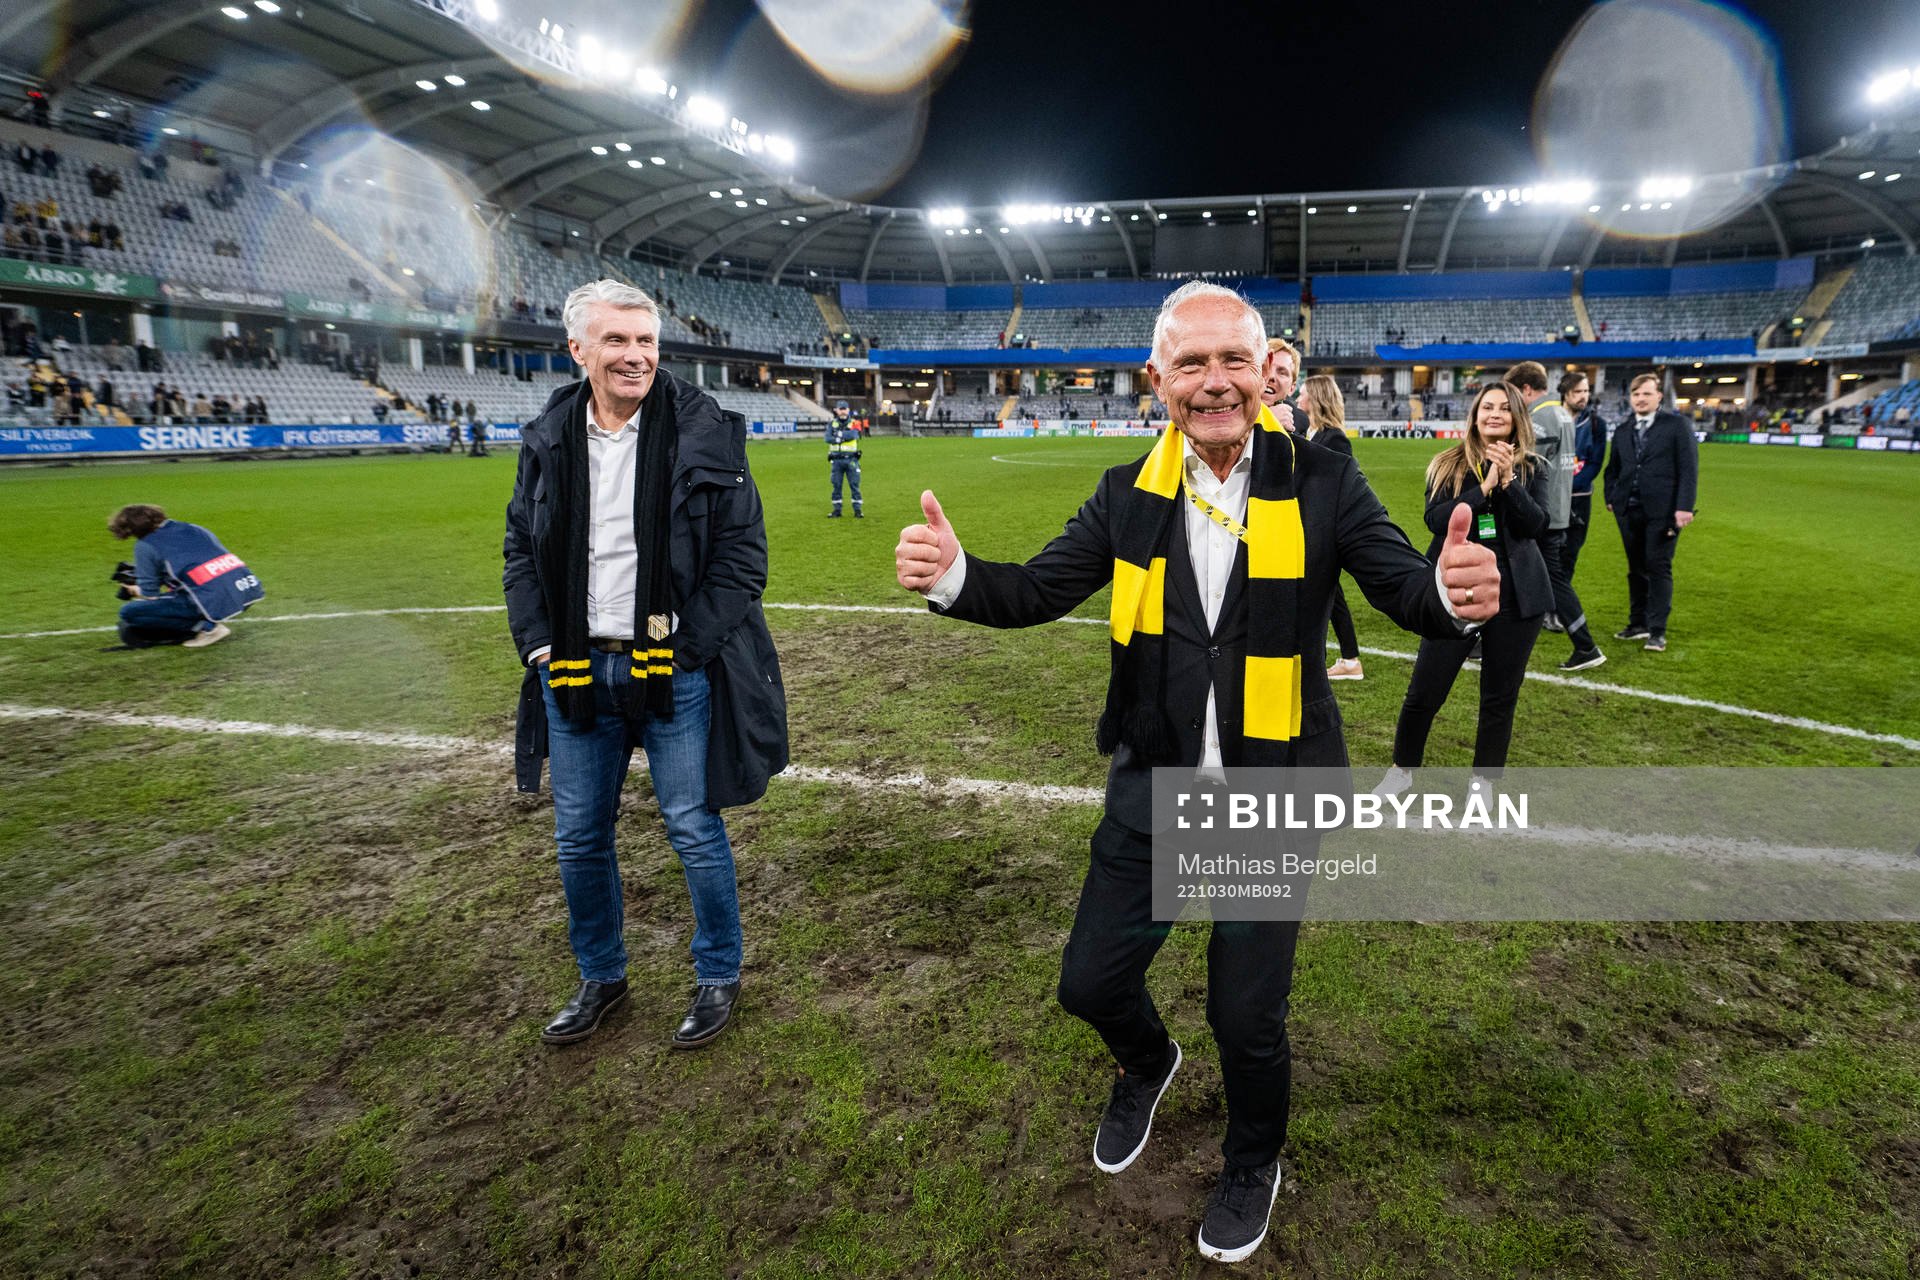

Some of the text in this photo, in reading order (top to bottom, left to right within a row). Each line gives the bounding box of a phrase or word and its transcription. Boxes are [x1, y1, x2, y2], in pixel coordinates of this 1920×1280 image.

[138, 426, 253, 450] SERNEKE
[283, 430, 309, 444] IFK
[402, 424, 469, 442] SERNEE
[1388, 430, 1433, 439] ELEDA
